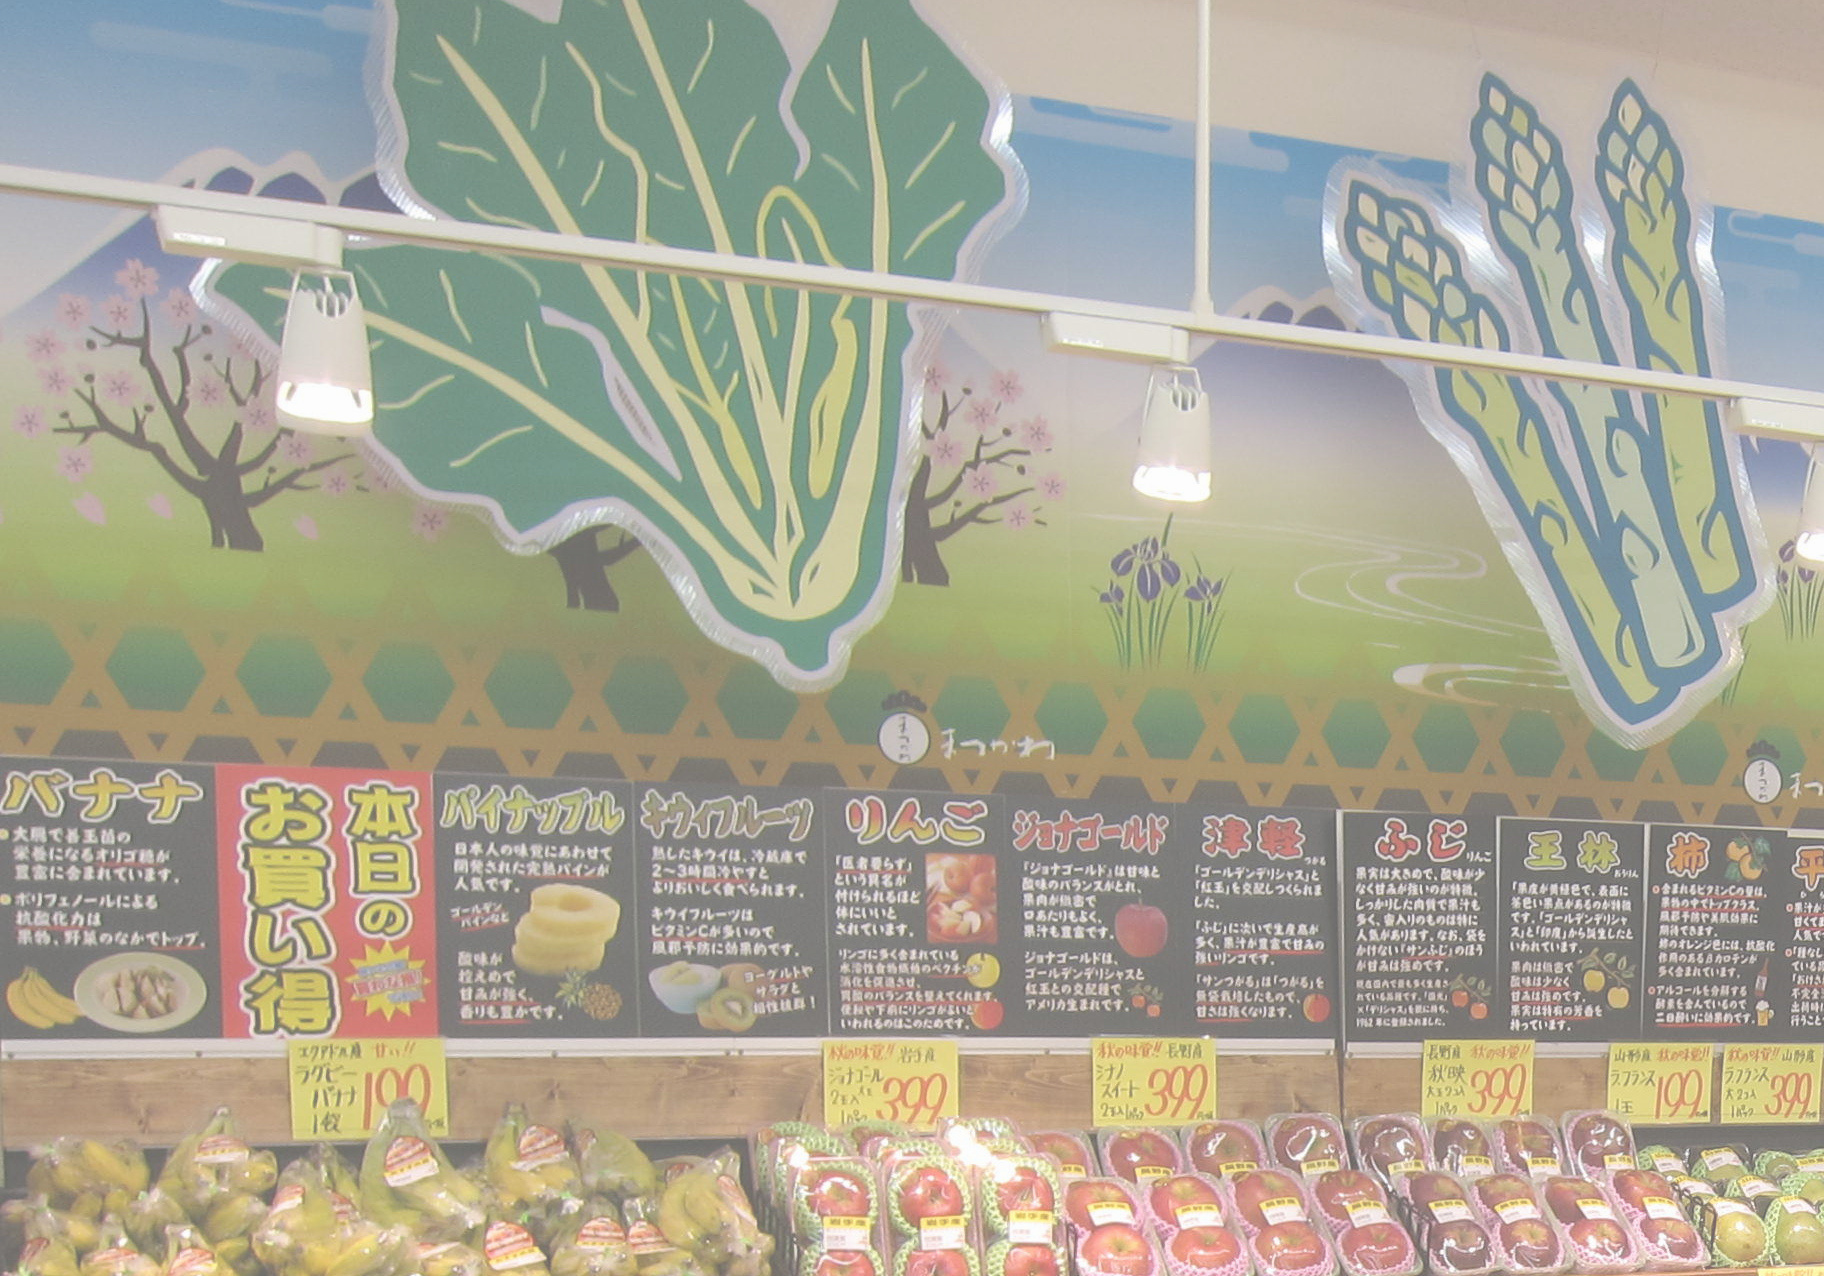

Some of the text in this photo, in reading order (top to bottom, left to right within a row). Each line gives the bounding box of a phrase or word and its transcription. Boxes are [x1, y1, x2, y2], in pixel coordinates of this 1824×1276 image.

[0, 768, 203, 823] バナナ
[440, 785, 625, 834] パイナップル
[846, 796, 988, 845] りんご
[1013, 810, 1168, 855] ジョナゴールド
[1202, 815, 1305, 859] 津軽
[1376, 818, 1467, 862] ふじ
[454, 843, 612, 860] 日本人の味覚にあわせて
[1524, 830, 1620, 874] 王林
[1666, 832, 1710, 879] 柿
[345, 782, 419, 940] 本日の
[454, 876, 520, 894] 人気です。
[652, 881, 804, 898] よりおいしく食べられます。
[1023, 878, 1142, 893] 酸味のバランスがとれ、
[15, 894, 158, 909] ポリフェノールによる
[834, 890, 920, 904] 付けられるほど
[1194, 897, 1220, 909] した。
[239, 779, 341, 1037] お買い得
[652, 907, 753, 922] キウイフルーツは
[836, 906, 896, 920] 体にいいと
[1024, 909, 1102, 922] 口あたりもよく、
[652, 924, 774, 939] ビタミンCが多いので
[835, 924, 914, 937] されています。
[1024, 925, 1114, 939] 果汁も豊富です。
[1659, 926, 1717, 937] 期待できます。
[839, 949, 958, 961] リンゴに多く含まれている
[1356, 944, 1483, 957] かけない「サンふじ」のほう
[1510, 942, 1583, 954] いわれています。
[458, 952, 502, 967] 酸味が
[1024, 952, 1118, 965] ジョナゴールドは、
[744, 966, 813, 982] ヨーグルトや
[1025, 967, 1144, 980] ゴールデンデリシャスと
[1658, 967, 1740, 979] 多く含まれています。
[1510, 976, 1569, 987] 酸味は少なく
[459, 987, 534, 1002] 甘みが強く、
[755, 982, 801, 997] サラダと
[1025, 983, 1120, 996] 紅玉との交配種で
[461, 1004, 562, 1020] 香りも豊かです。
[1026, 998, 1129, 1011] アメリカ生まれです。
[1196, 1006, 1292, 1019] 甘さは強くなります。
[840, 1018, 970, 1030] いわれるのはこのためです。
[1510, 1019, 1572, 1032] 持っています。
[1615, 1049, 1650, 1062] 山形産
[1782, 1050, 1815, 1062] 山形産
[1102, 1080, 1140, 1098] スイート
[1144, 1064, 1208, 1119] 399
[1468, 1064, 1526, 1116] 399
[1655, 1069, 1703, 1119] 199
[1764, 1073, 1813, 1119] 399
[876, 1073, 947, 1124] 399
